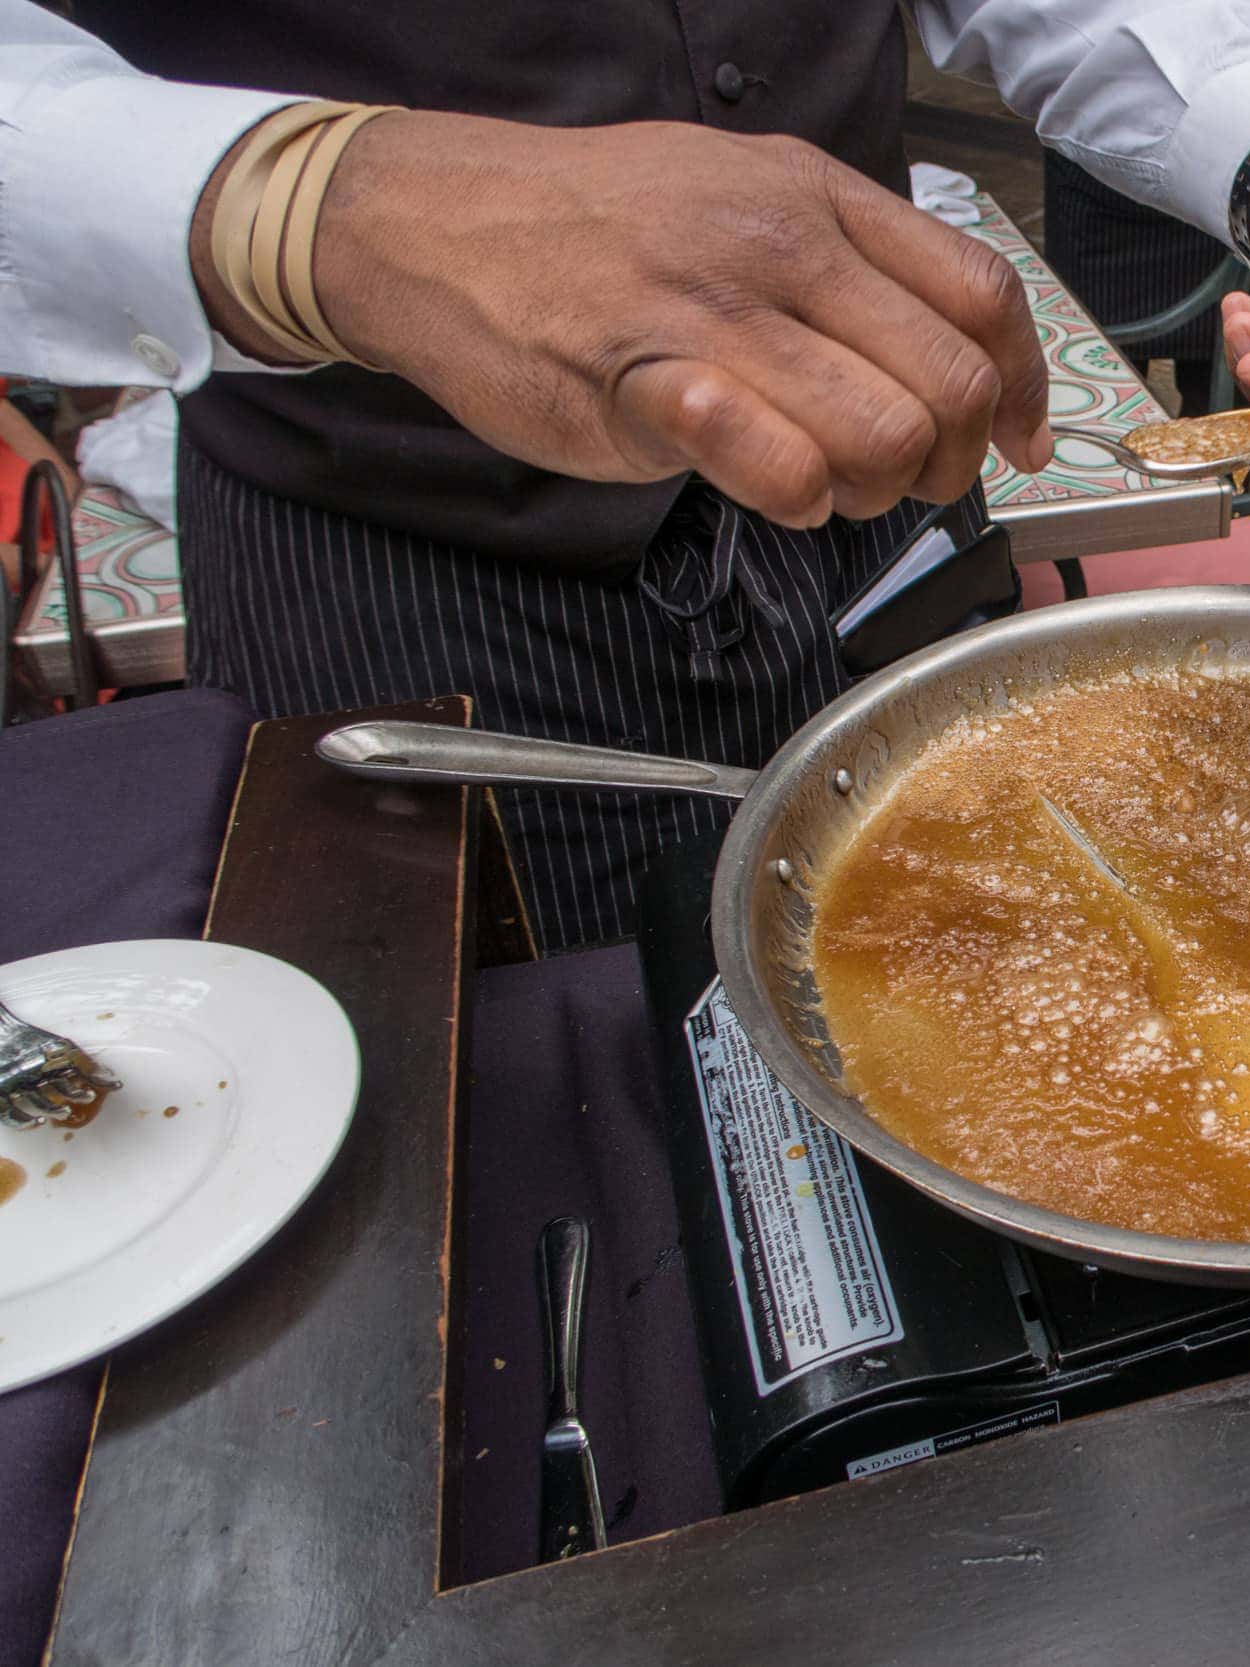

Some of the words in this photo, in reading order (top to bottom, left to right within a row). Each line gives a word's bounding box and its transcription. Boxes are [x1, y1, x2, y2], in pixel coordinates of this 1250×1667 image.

[773, 1092, 791, 1139] Instructions
[791, 1099, 808, 1135] additional
[834, 1174, 847, 1193] This
[840, 1194, 855, 1219] stove
[818, 1159, 831, 1180] stove
[839, 1238, 859, 1282] structures.
[852, 1284, 868, 1318] Provide
[823, 1223, 835, 1239] and
[847, 1219, 868, 1266] consumes
[828, 1240, 846, 1281] additional
[861, 1267, 872, 1281] air
[839, 1282, 859, 1330] occupants.
[862, 1282, 886, 1328] (oxygen).
[871, 1446, 931, 1469] DANGER
